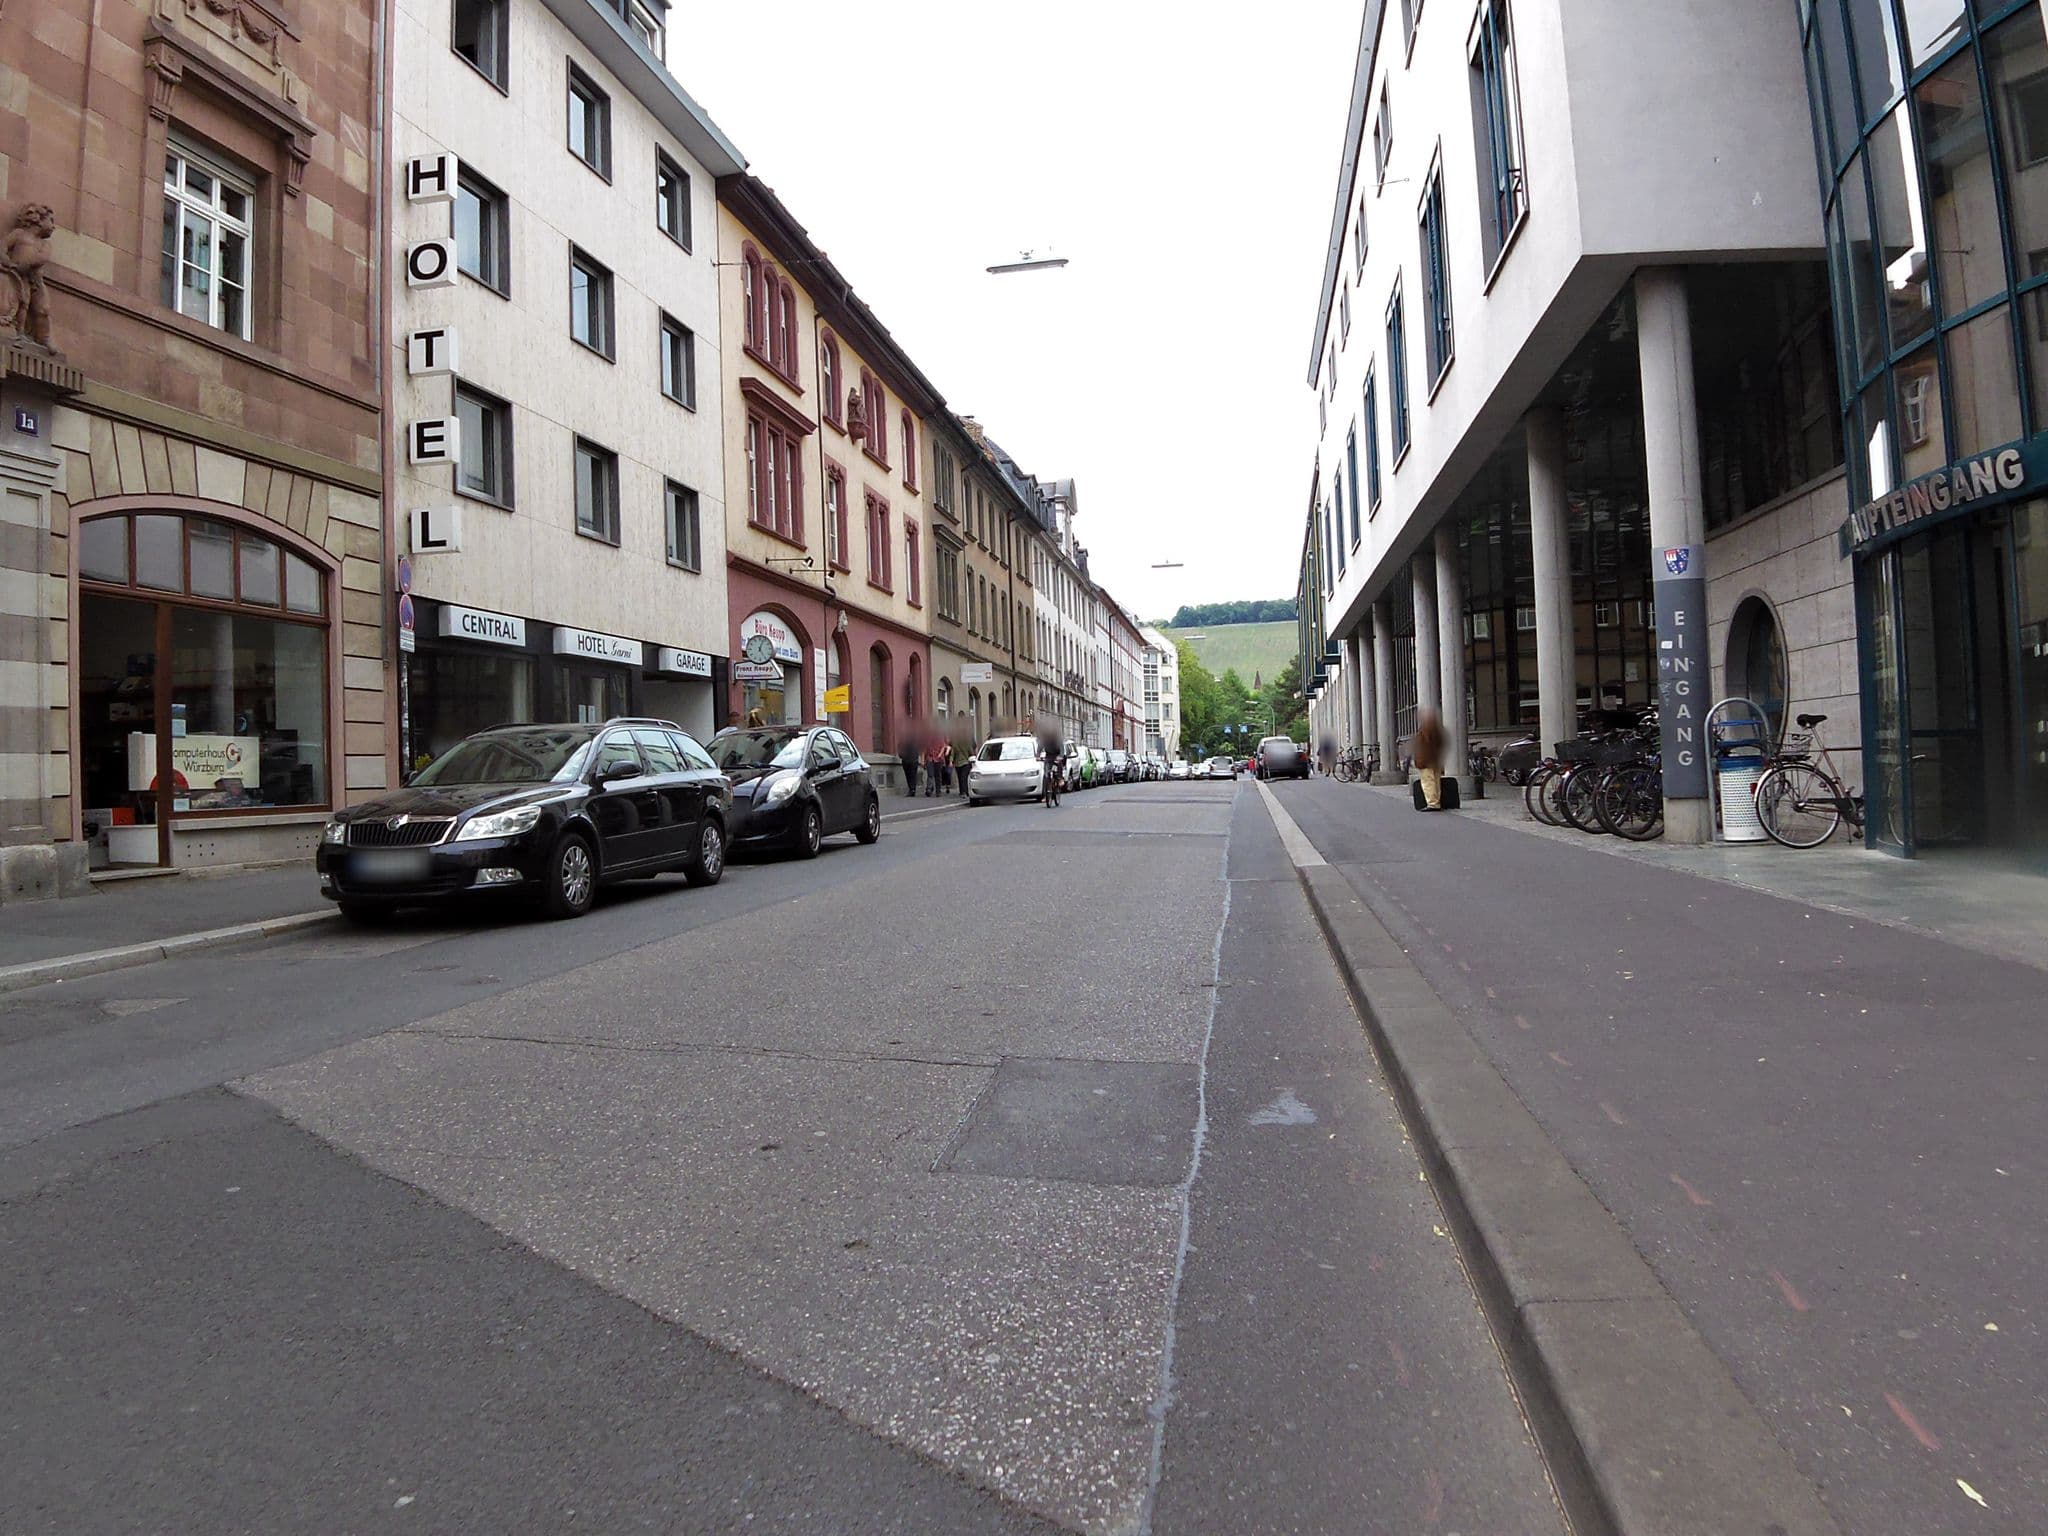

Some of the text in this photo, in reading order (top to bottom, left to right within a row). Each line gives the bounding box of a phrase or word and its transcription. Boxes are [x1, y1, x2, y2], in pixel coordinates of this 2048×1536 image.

[410, 156, 447, 548] HOTEL
[21, 413, 34, 430] 1a
[1851, 449, 2024, 545] AUPTEINGANG
[462, 614, 517, 640] CENTRAL
[577, 634, 632, 659] HOTEL Garni
[676, 653, 705, 671] GARAGE
[1674, 611, 1694, 766] EINGANG
[174, 744, 226, 760] omputerhaus
[183, 759, 225, 773] Würzburg
